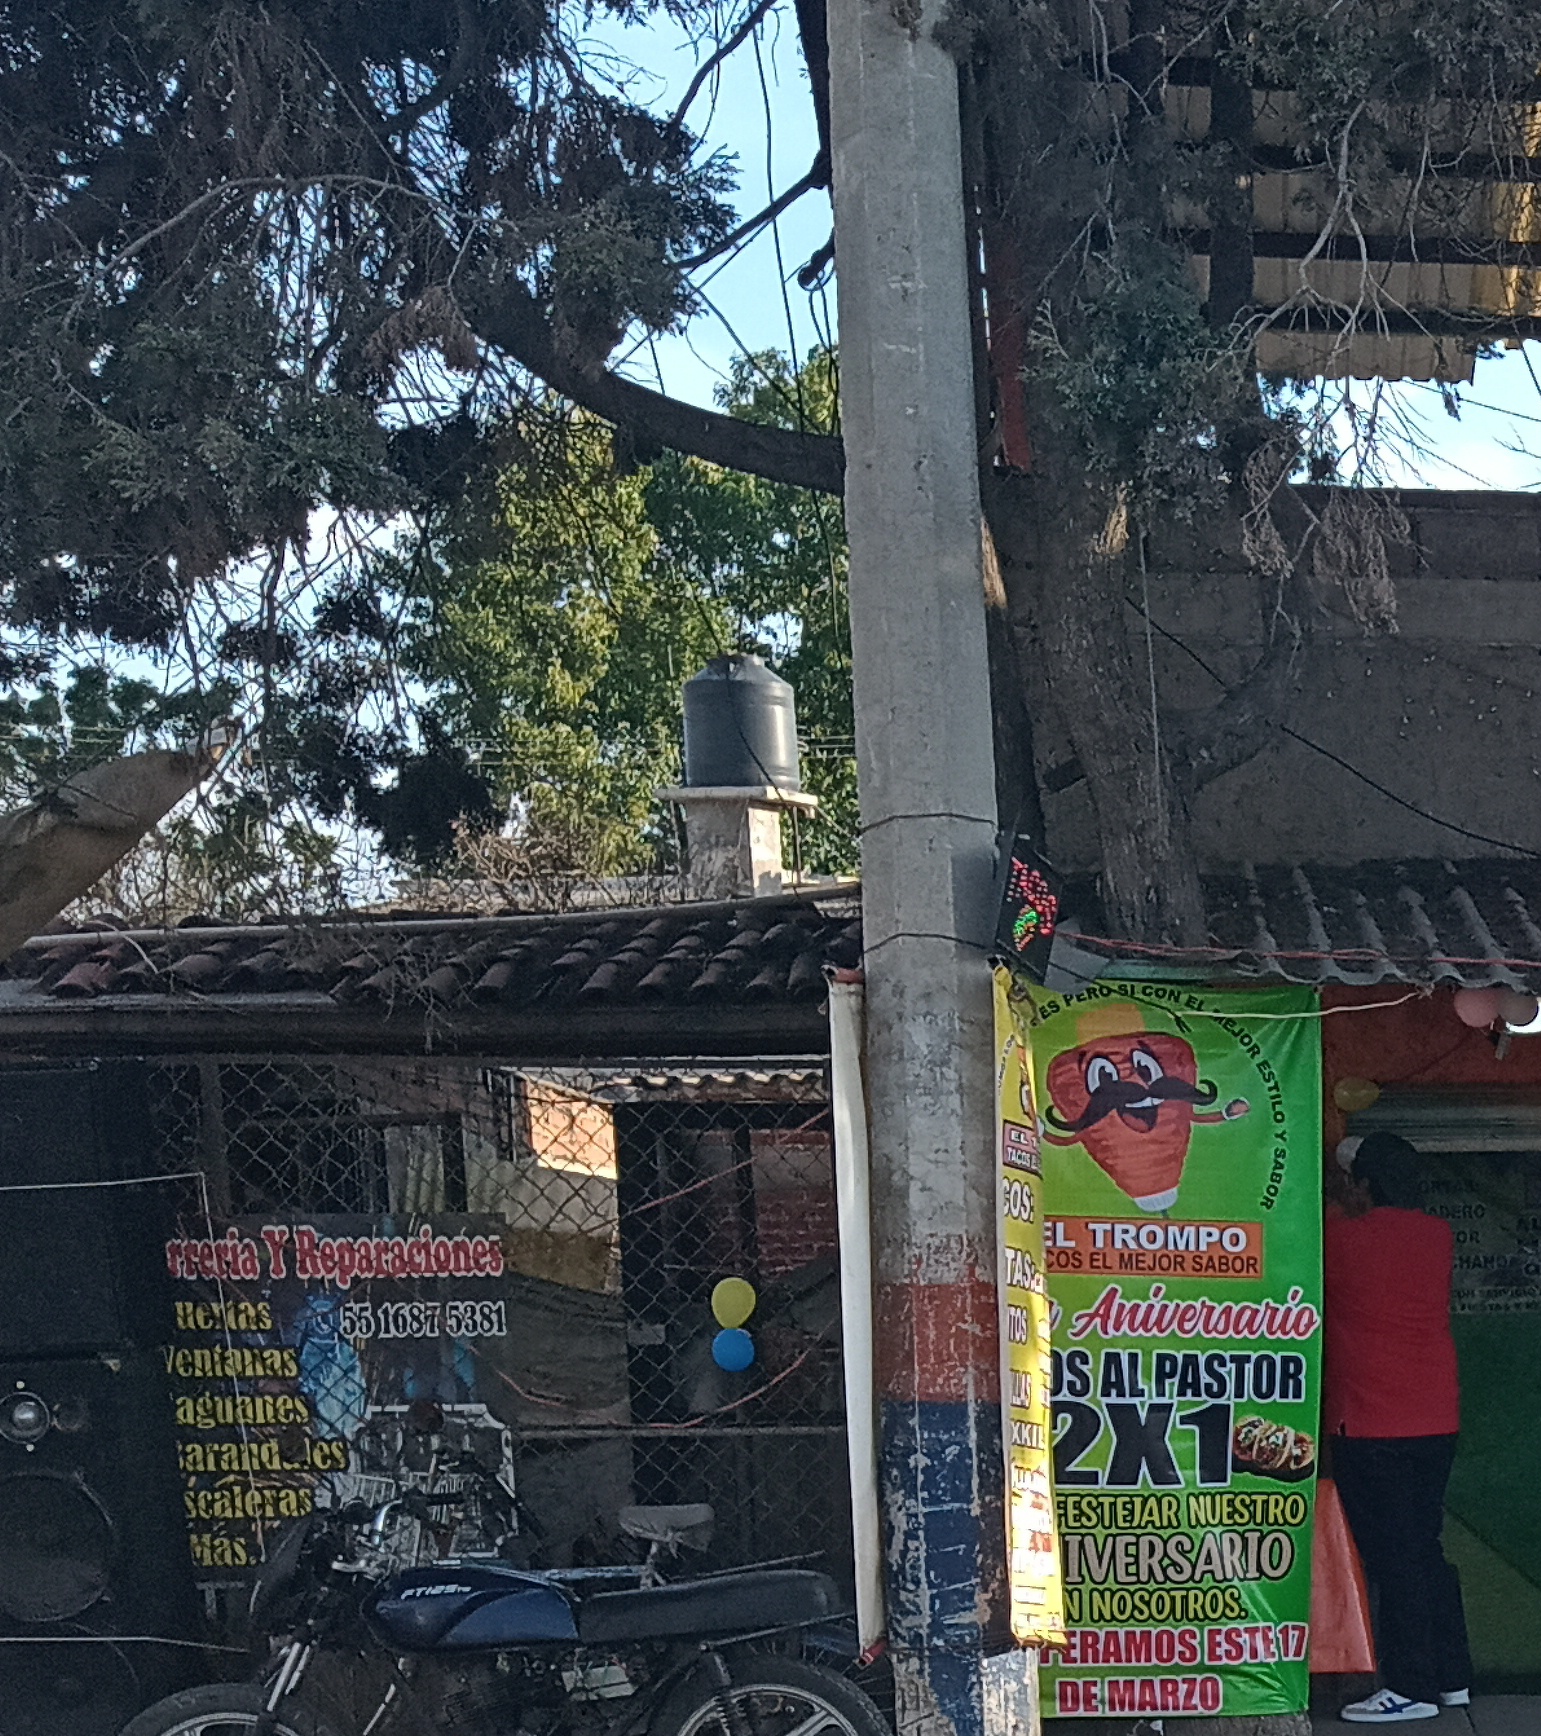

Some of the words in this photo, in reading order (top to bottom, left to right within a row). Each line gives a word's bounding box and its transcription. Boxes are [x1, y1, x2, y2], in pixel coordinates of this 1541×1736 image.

[1063, 984, 1112, 1008] PERO
[1116, 983, 1137, 998] SI
[1141, 985, 1182, 1005] CON
[1186, 995, 1207, 1013] EL
[1212, 1008, 1262, 1061] MEJOR
[1255, 1059, 1286, 1125] ESTILO
[1273, 1128, 1287, 1143] Y
[1002, 1175, 1035, 1223] COS:
[1260, 1147, 1288, 1213] SABOR
[1045, 1221, 1076, 1248] EL
[1087, 1222, 1248, 1253] TROMPO
[165, 1227, 260, 1281] rreria
[261, 1224, 289, 1280] Y
[293, 1223, 504, 1291] Reparaciones
[1046, 1250, 1083, 1270] COS
[1089, 1252, 1112, 1271] EL
[1118, 1252, 1186, 1272] MEJOR
[1191, 1255, 1260, 1274] SABOR
[174, 1300, 273, 1331] uertas
[339, 1302, 375, 1340] 55
[377, 1301, 441, 1340] 1687
[446, 1300, 507, 1338] 5381
[1068, 1282, 1322, 1340] Aniversario
[1099, 1348, 1146, 1400] AL
[1153, 1350, 1306, 1402] PASTOR
[174, 1391, 310, 1429] aguanes
[178, 1437, 349, 1472] arandles
[1051, 1399, 1234, 1490] 2X1
[184, 1485, 314, 1520] scaleras
[1056, 1493, 1181, 1530] FESTEJAR
[1187, 1491, 1308, 1529] NUESTRO
[1063, 1529, 1296, 1586] IVERSARIO
[1091, 1586, 1249, 1623] NOSOTROS.
[1039, 1625, 1200, 1667] ERAMOS
[1204, 1623, 1278, 1665] ESTE
[1278, 1621, 1310, 1662] 17
[1055, 1677, 1101, 1717] DE
[1105, 1673, 1224, 1716] MARZO
